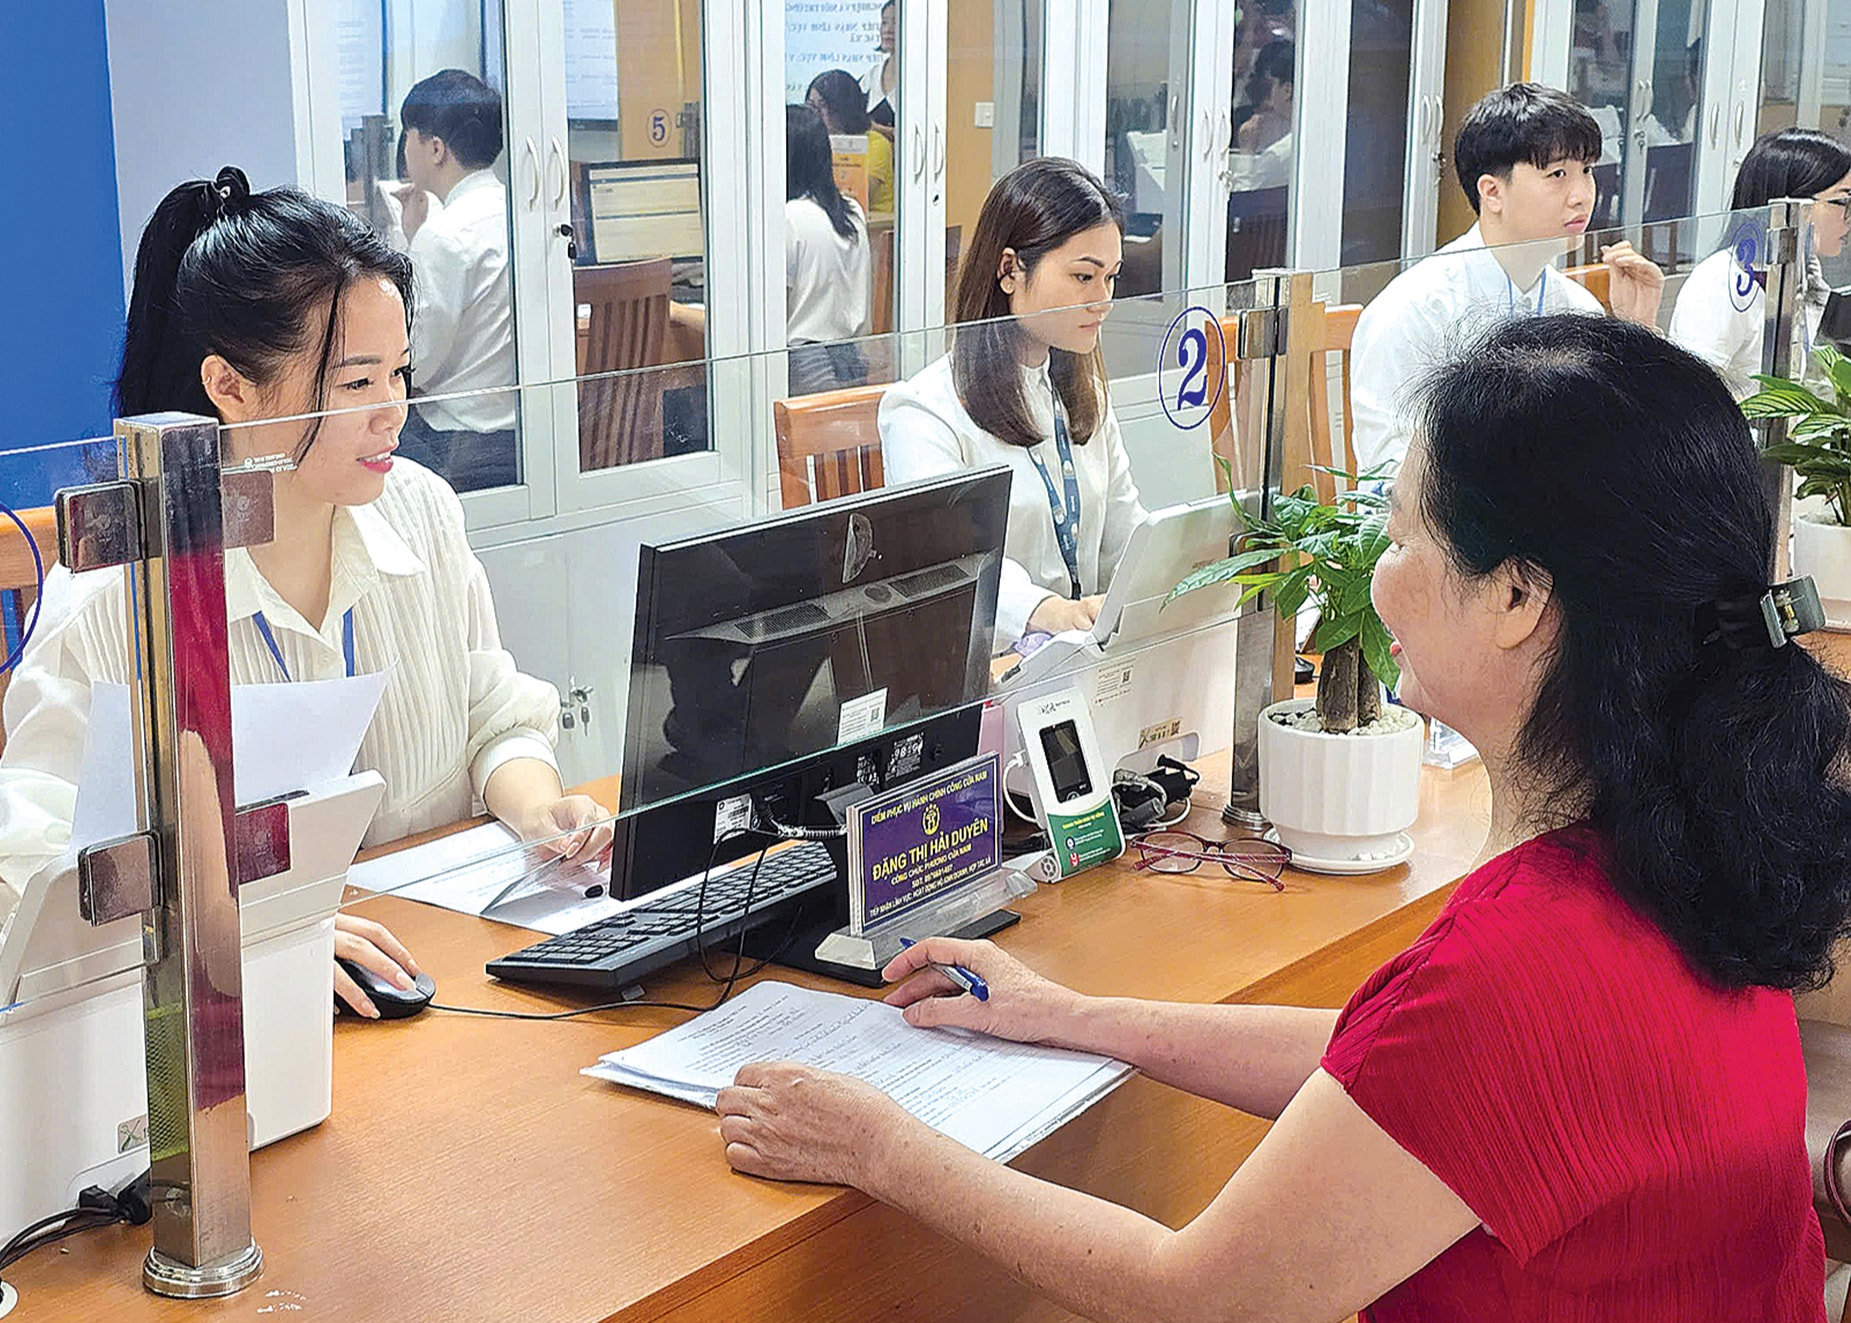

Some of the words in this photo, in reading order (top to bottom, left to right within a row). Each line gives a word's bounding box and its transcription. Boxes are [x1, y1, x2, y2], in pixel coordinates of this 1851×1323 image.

[652, 115, 665, 142] 5
[1736, 238, 1756, 297] 3
[1177, 328, 1208, 411] 2
[872, 853, 907, 880] ĐẶNG
[909, 843, 928, 866] THỊ
[931, 831, 949, 856] HẢI
[951, 818, 988, 846] DUYÊN
